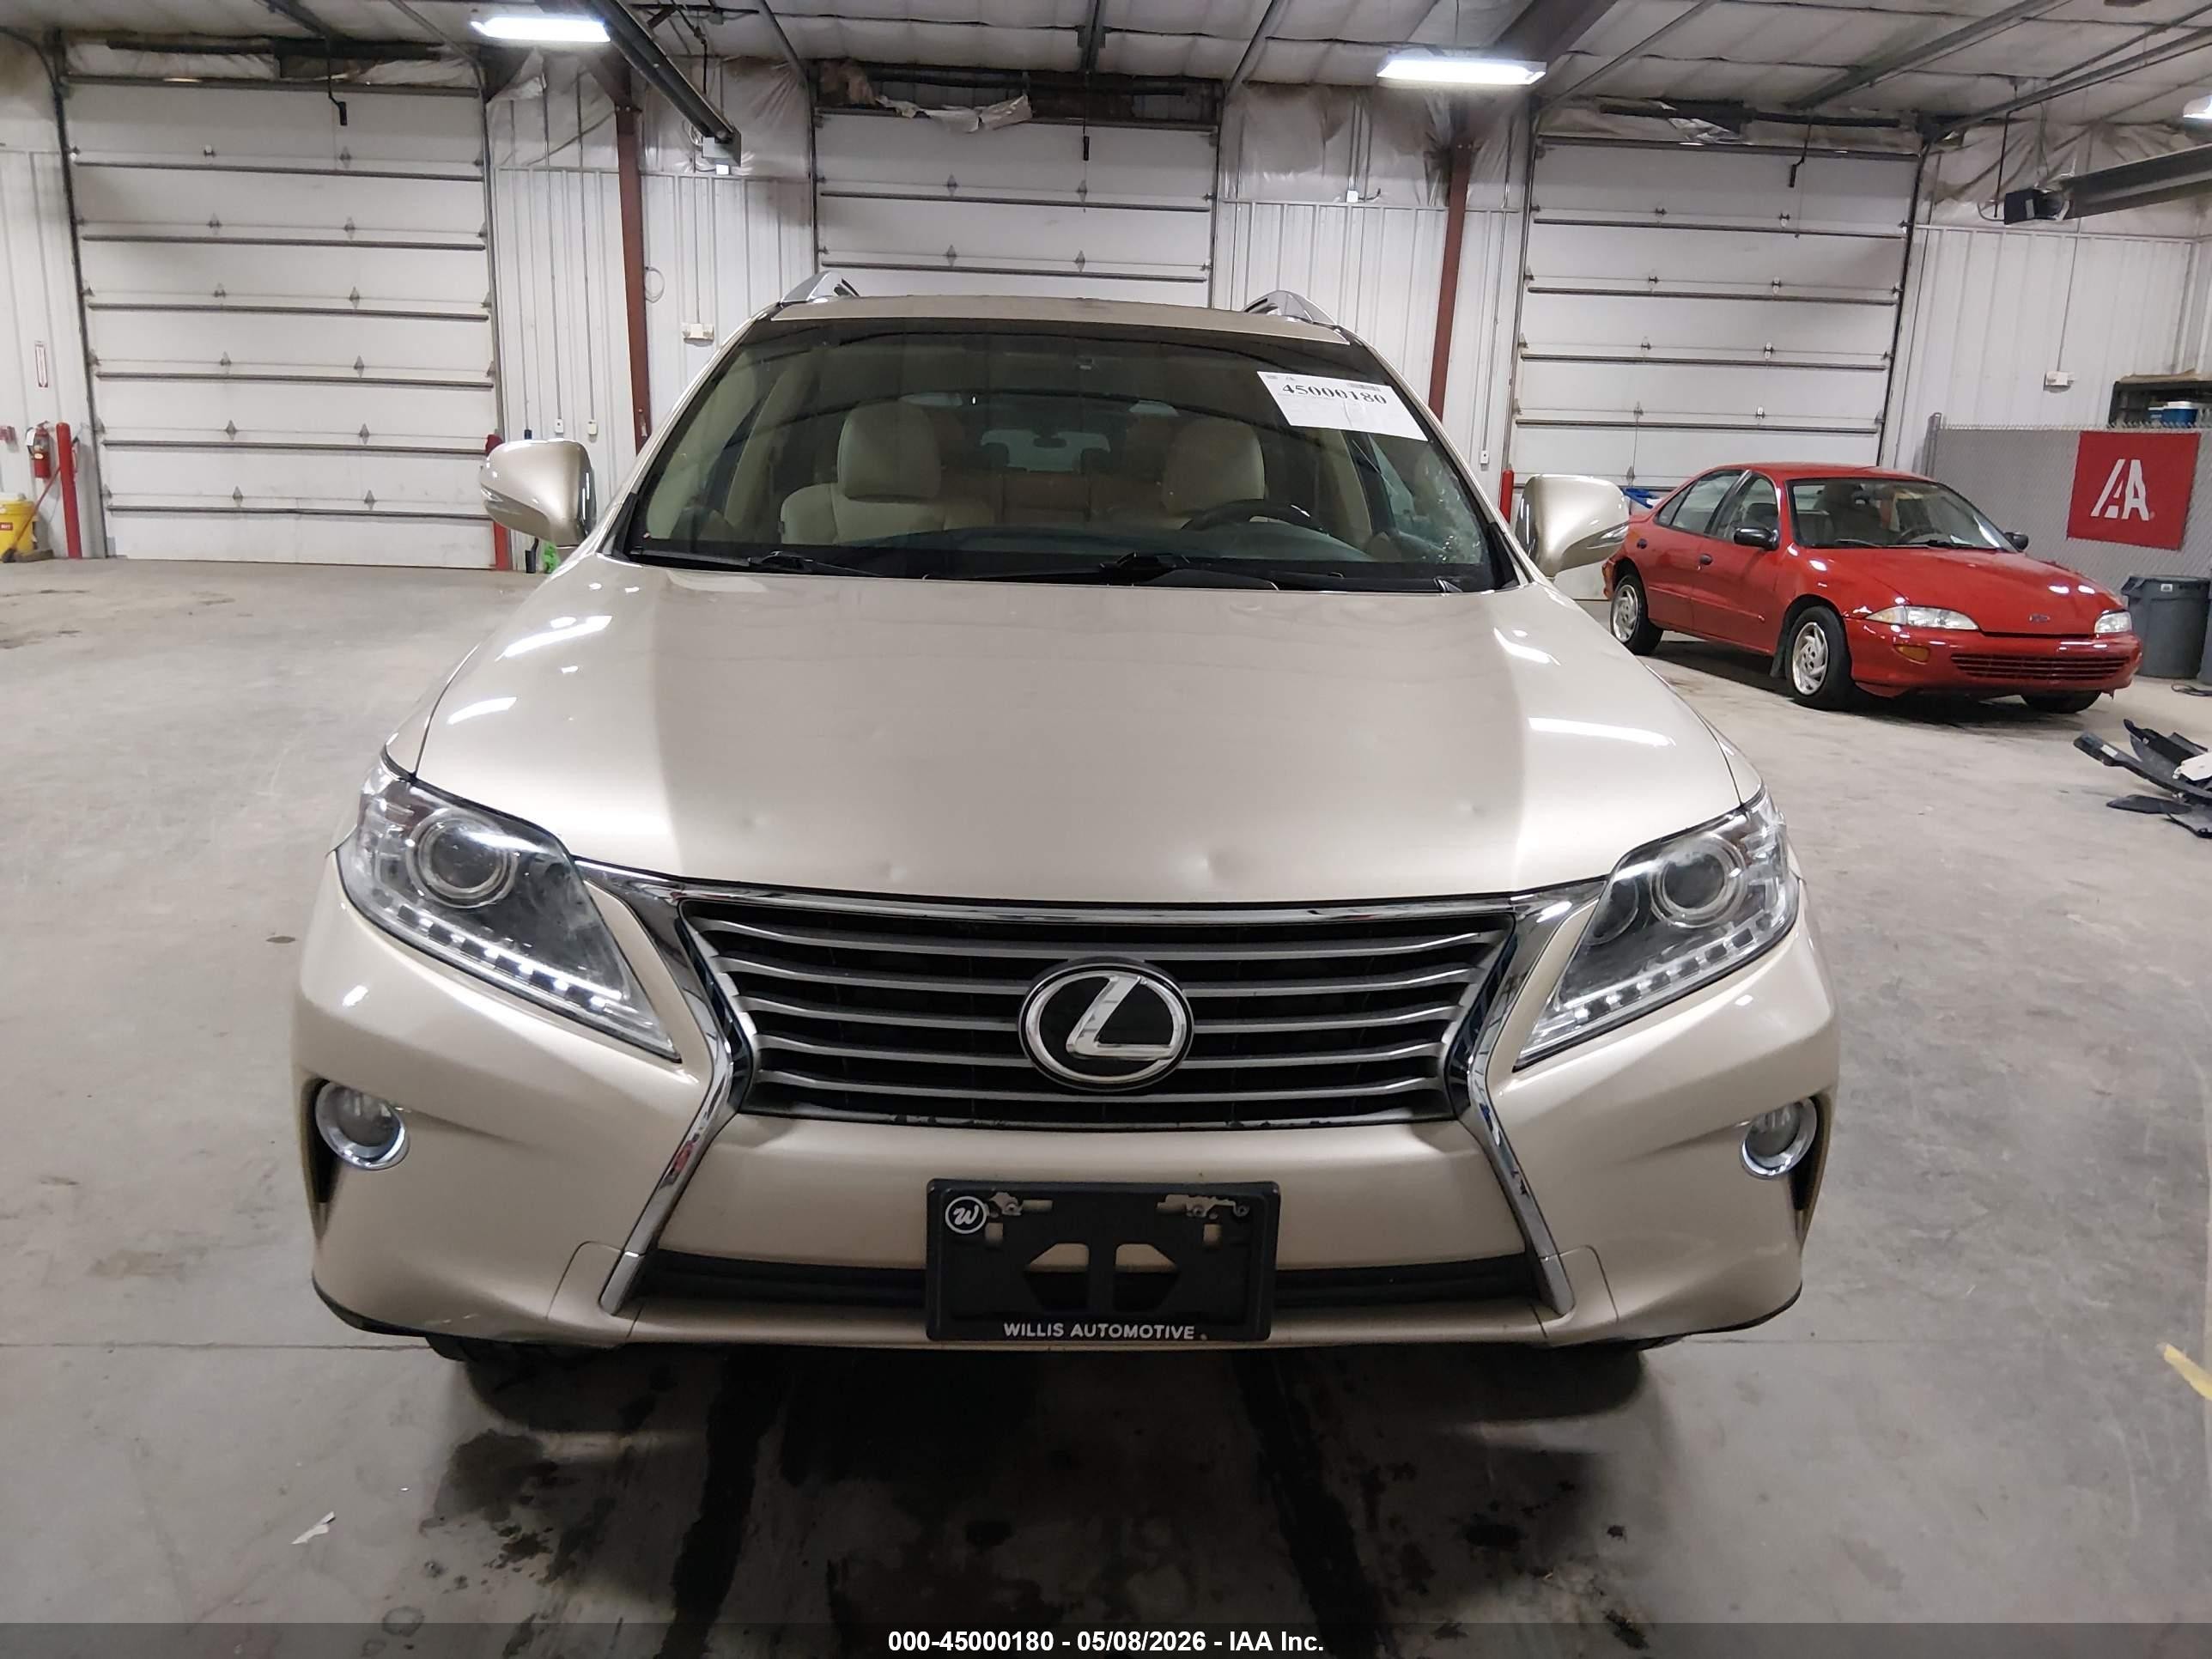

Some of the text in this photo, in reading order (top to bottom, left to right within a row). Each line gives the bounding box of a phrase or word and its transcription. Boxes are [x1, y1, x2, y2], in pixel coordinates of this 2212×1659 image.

[1282, 384, 1388, 404] 45000180
[1004, 1322, 1194, 1340] WILLIS AUTOMOTIVE
